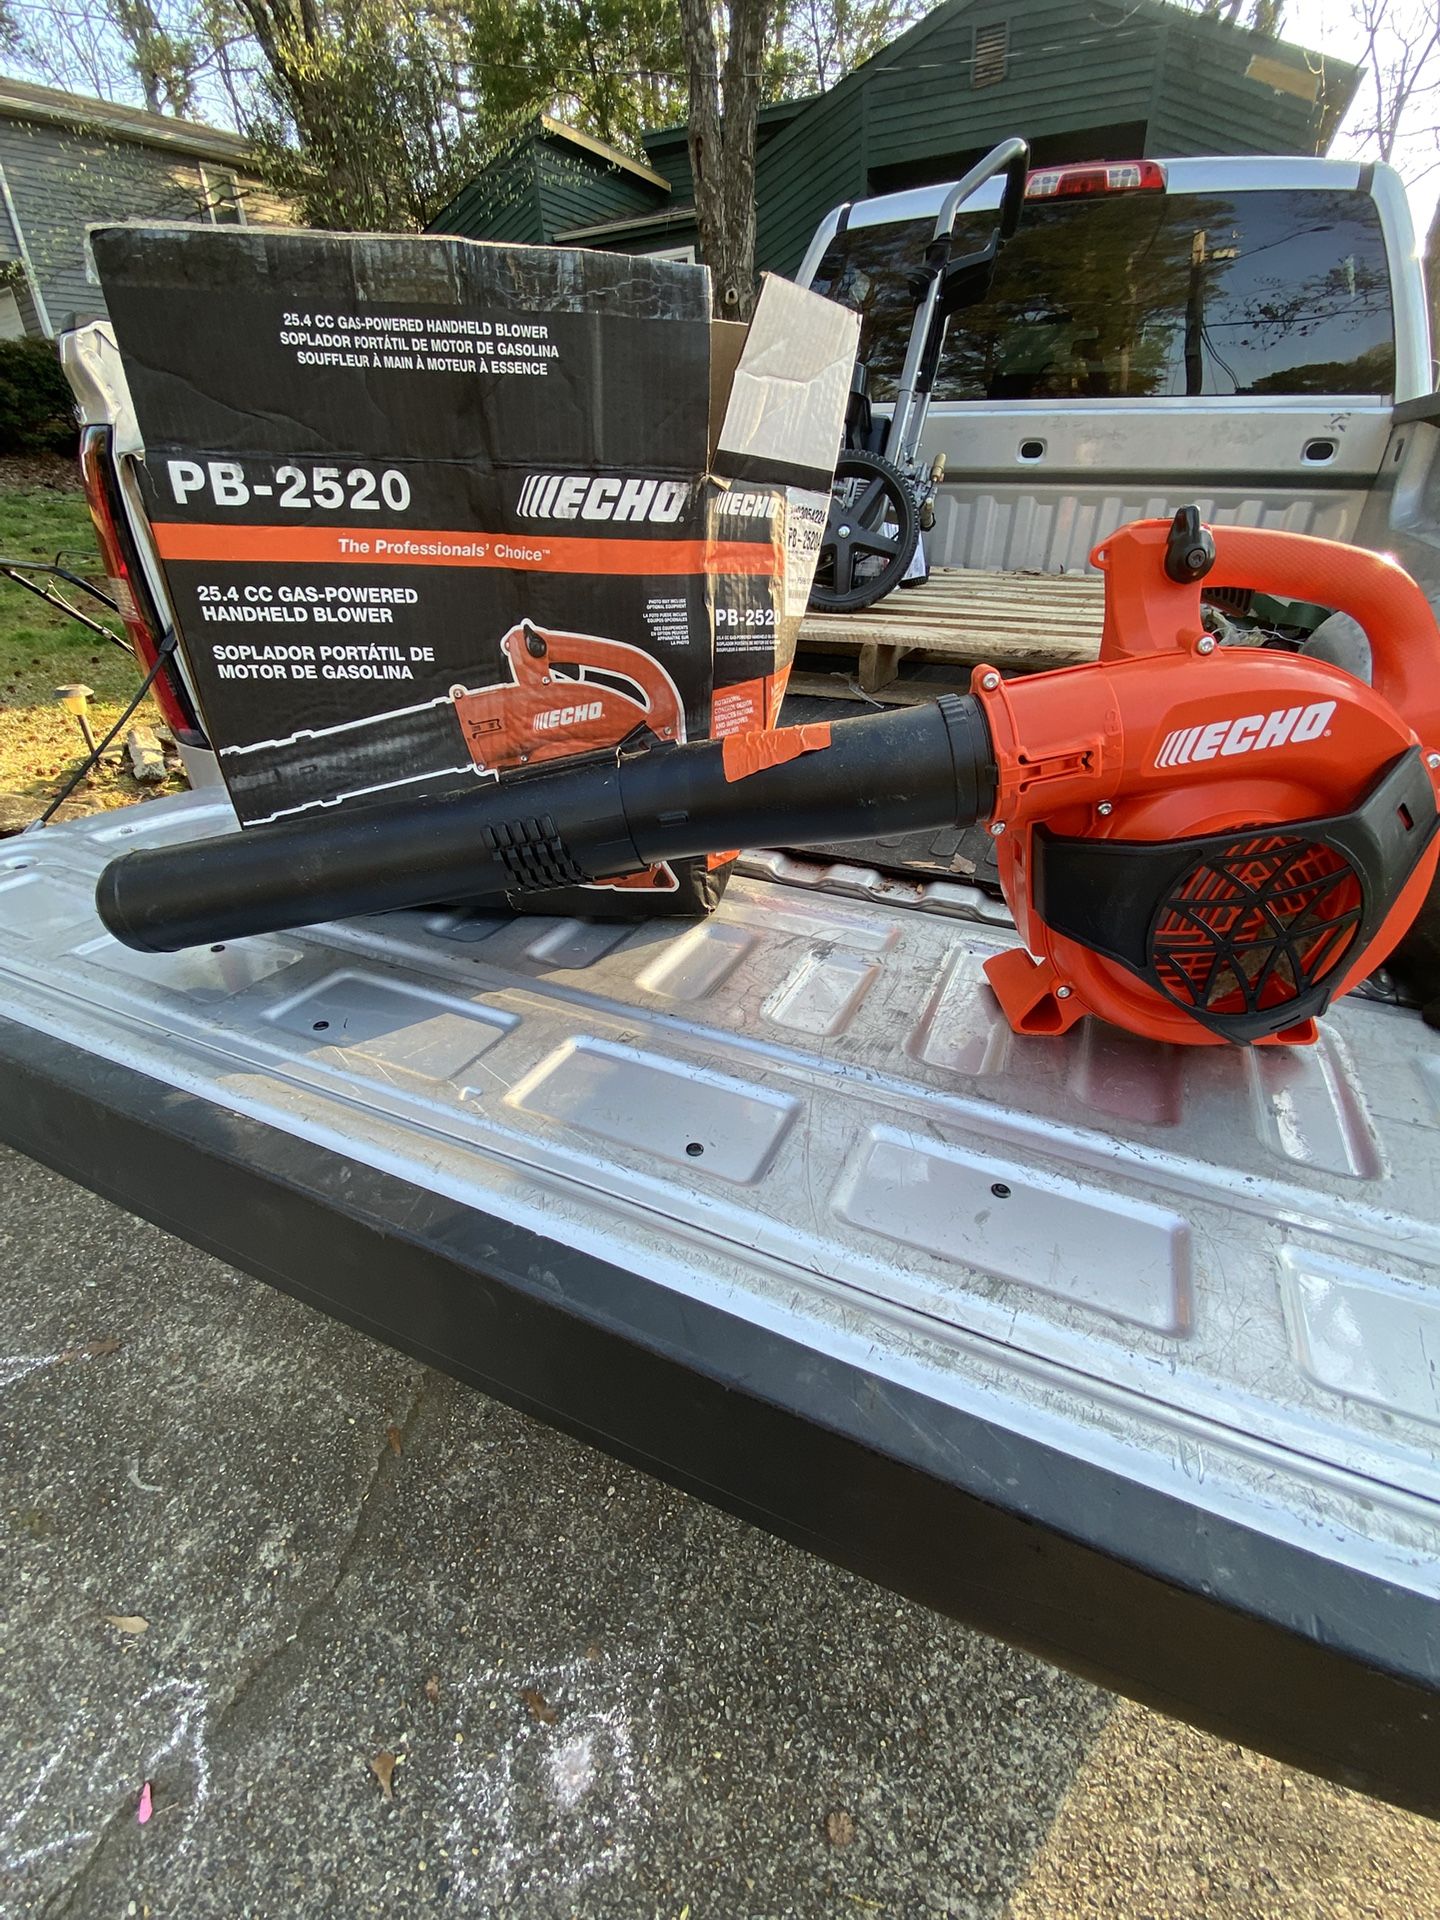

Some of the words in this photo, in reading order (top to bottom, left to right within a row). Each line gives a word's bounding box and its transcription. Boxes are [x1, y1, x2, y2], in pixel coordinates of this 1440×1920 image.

[283, 313, 312, 327] 25.4
[315, 315, 334, 329] CC
[338, 316, 424, 332] GAS-POWERED
[426, 319, 492, 336] HANDHELD
[495, 323, 549, 339] BLOWER
[280, 331, 352, 348] SOPLADOR
[354, 334, 409, 351] PORTÁTIL
[412, 338, 428, 351] DE
[431, 338, 473, 354] MOTOR
[477, 341, 494, 355] DE
[497, 342, 559, 358] GASOLINA
[297, 351, 370, 367] SOUFFLEUR
[373, 352, 382, 368] À
[384, 356, 414, 370] MAIN
[416, 354, 425, 370] À
[428, 357, 476, 373] MOTEUR
[480, 357, 489, 374] À
[491, 361, 548, 376] ESSENCE
[167, 461, 411, 512] PB-2520
[552, 476, 690, 523] ECHO
[728, 492, 780, 519] ECHO
[338, 538, 370, 553] The
[375, 540, 490, 558] Professionals’
[197, 586, 239, 601] 25.4
[244, 586, 273, 601] CC
[278, 587, 418, 604] GAS-POWERED
[202, 606, 308, 622] HANDHELD
[313, 607, 394, 623] BLOWER
[715, 608, 781, 627] PB-2520
[212, 645, 315, 661] SOPLADOR
[319, 643, 406, 661] PORTÁTIL
[410, 647, 435, 662] DE
[217, 665, 287, 679] MOTOR
[291, 665, 318, 679] DE
[322, 665, 414, 680] GASOLINA
[549, 701, 603, 728] ECHO
[1191, 701, 1337, 762] ECHO
